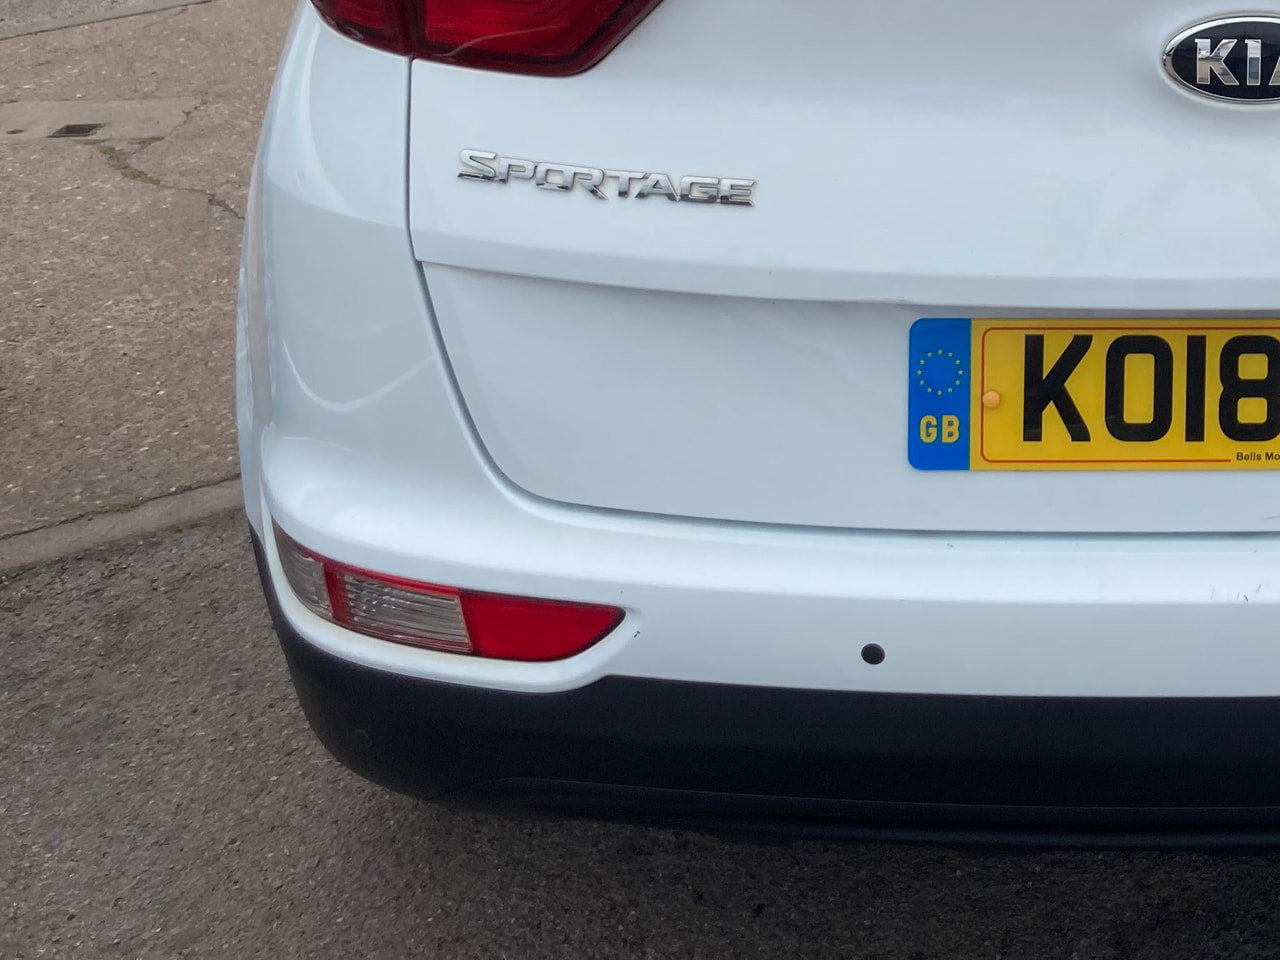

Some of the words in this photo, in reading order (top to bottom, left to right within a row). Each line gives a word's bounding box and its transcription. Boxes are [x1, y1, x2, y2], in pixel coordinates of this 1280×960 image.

[457, 148, 757, 208] SPORTAGE
[920, 414, 960, 444] GB
[1236, 451, 1262, 461] Bells
